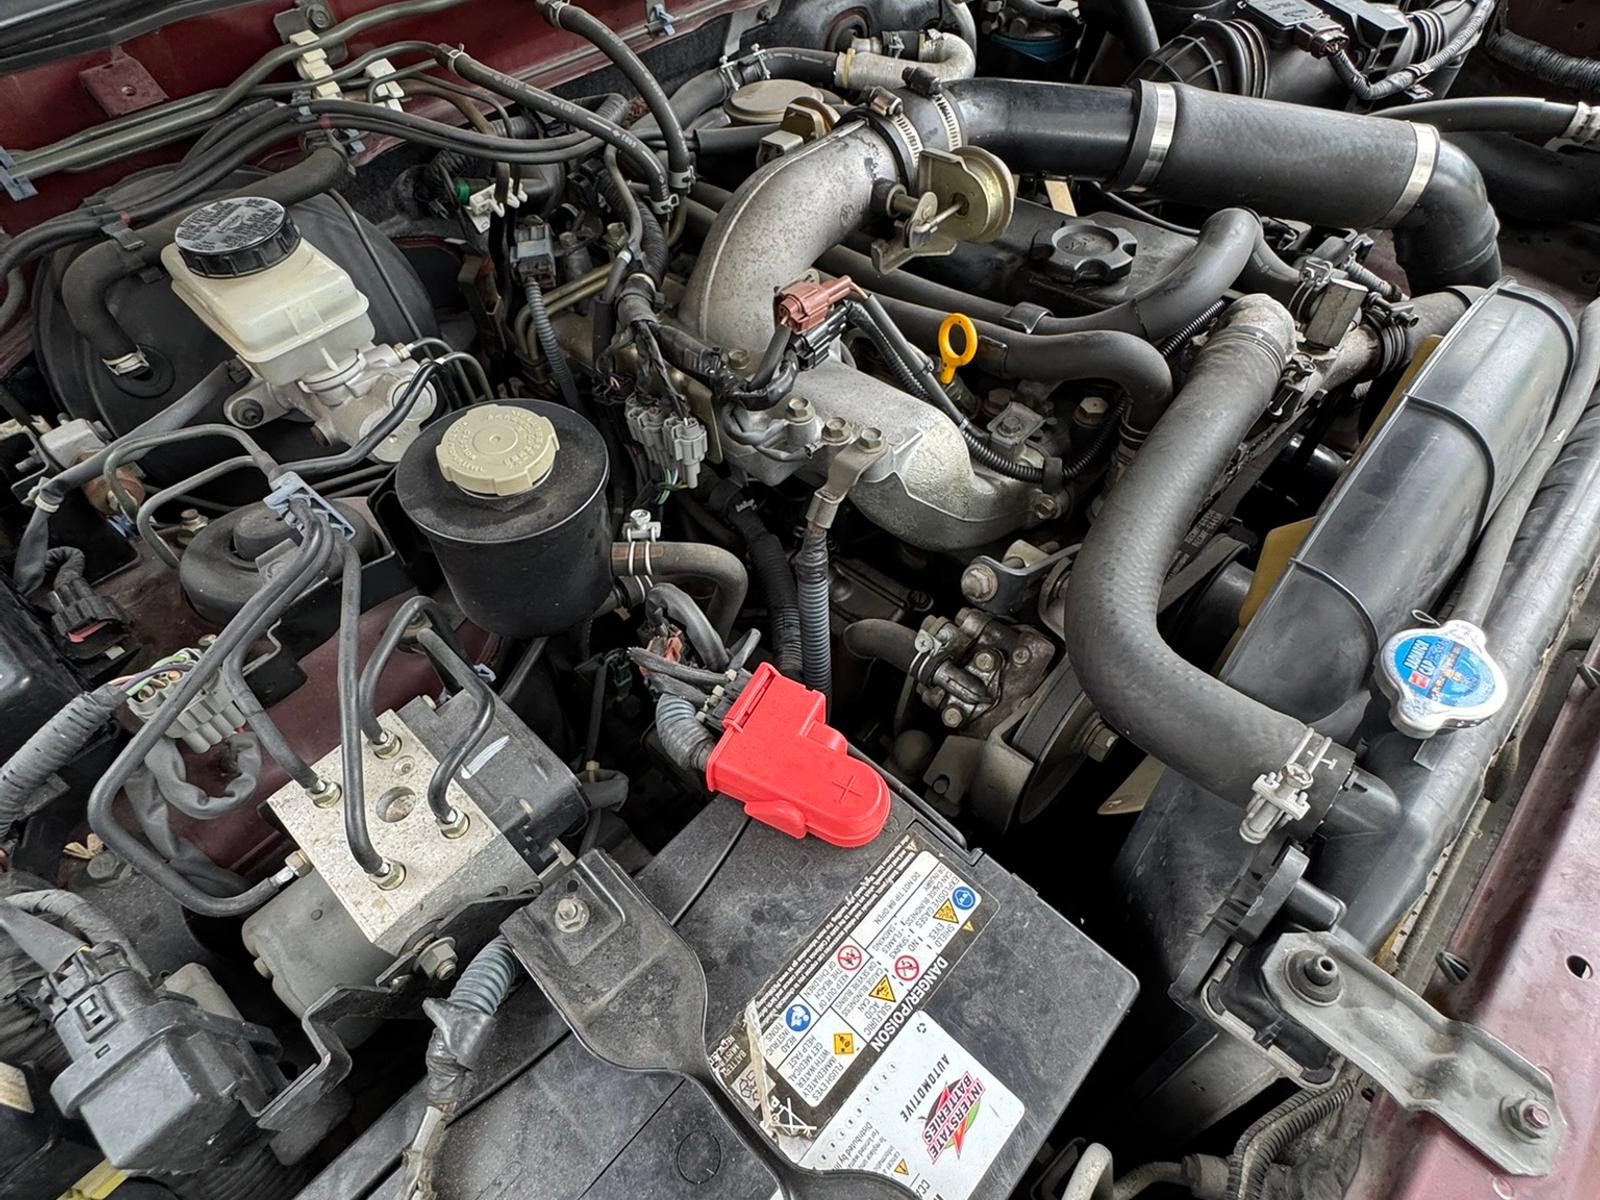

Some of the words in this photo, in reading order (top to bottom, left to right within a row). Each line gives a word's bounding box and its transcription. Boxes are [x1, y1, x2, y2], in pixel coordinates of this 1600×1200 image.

[1403, 638, 1430, 671] RADIATOR
[1418, 658, 1437, 678] CAP
[900, 879, 913, 892] NOT
[931, 876, 959, 907] EXPLOSIVE
[914, 906, 934, 928] GASES
[906, 938, 919, 952] NO
[933, 923, 954, 947] SHIELD
[825, 960, 836, 971] OF
[829, 967, 842, 980] THE
[866, 960, 876, 971] OR
[802, 968, 829, 998] CHILDREN
[833, 973, 849, 989] KEEP
[849, 968, 870, 992] SEVERE
[865, 967, 883, 987] CAUSE
[813, 978, 833, 999] REACH
[824, 987, 837, 1001] OUT
[816, 999, 827, 1010] OF
[840, 984, 869, 1017] BLINDNESS
[857, 997, 871, 1012] CAN
[863, 1000, 880, 1019] ACID
[869, 955, 948, 1052] DANGER/POISON
[862, 1001, 891, 1035] SULFURIC
[722, 1042, 740, 1061] MUST
[779, 1034, 797, 1053] READ
[799, 1034, 816, 1053] HELP
[809, 1041, 823, 1056] GET
[785, 1050, 803, 1069] FAST.
[812, 1048, 830, 1067] WITH
[786, 1053, 813, 1083] MEDICAL
[800, 1055, 837, 1098] IMMEDIATELY
[824, 1062, 844, 1084] FLUSH
[810, 1081, 828, 1101] EYES
[897, 1053, 952, 1123] AUTOMOTIVE
[920, 1074, 974, 1144] BATTERIES
[926, 1080, 985, 1159] INTERSTATE
[844, 1120, 873, 1156] Distributed
[836, 1151, 848, 1164] by
